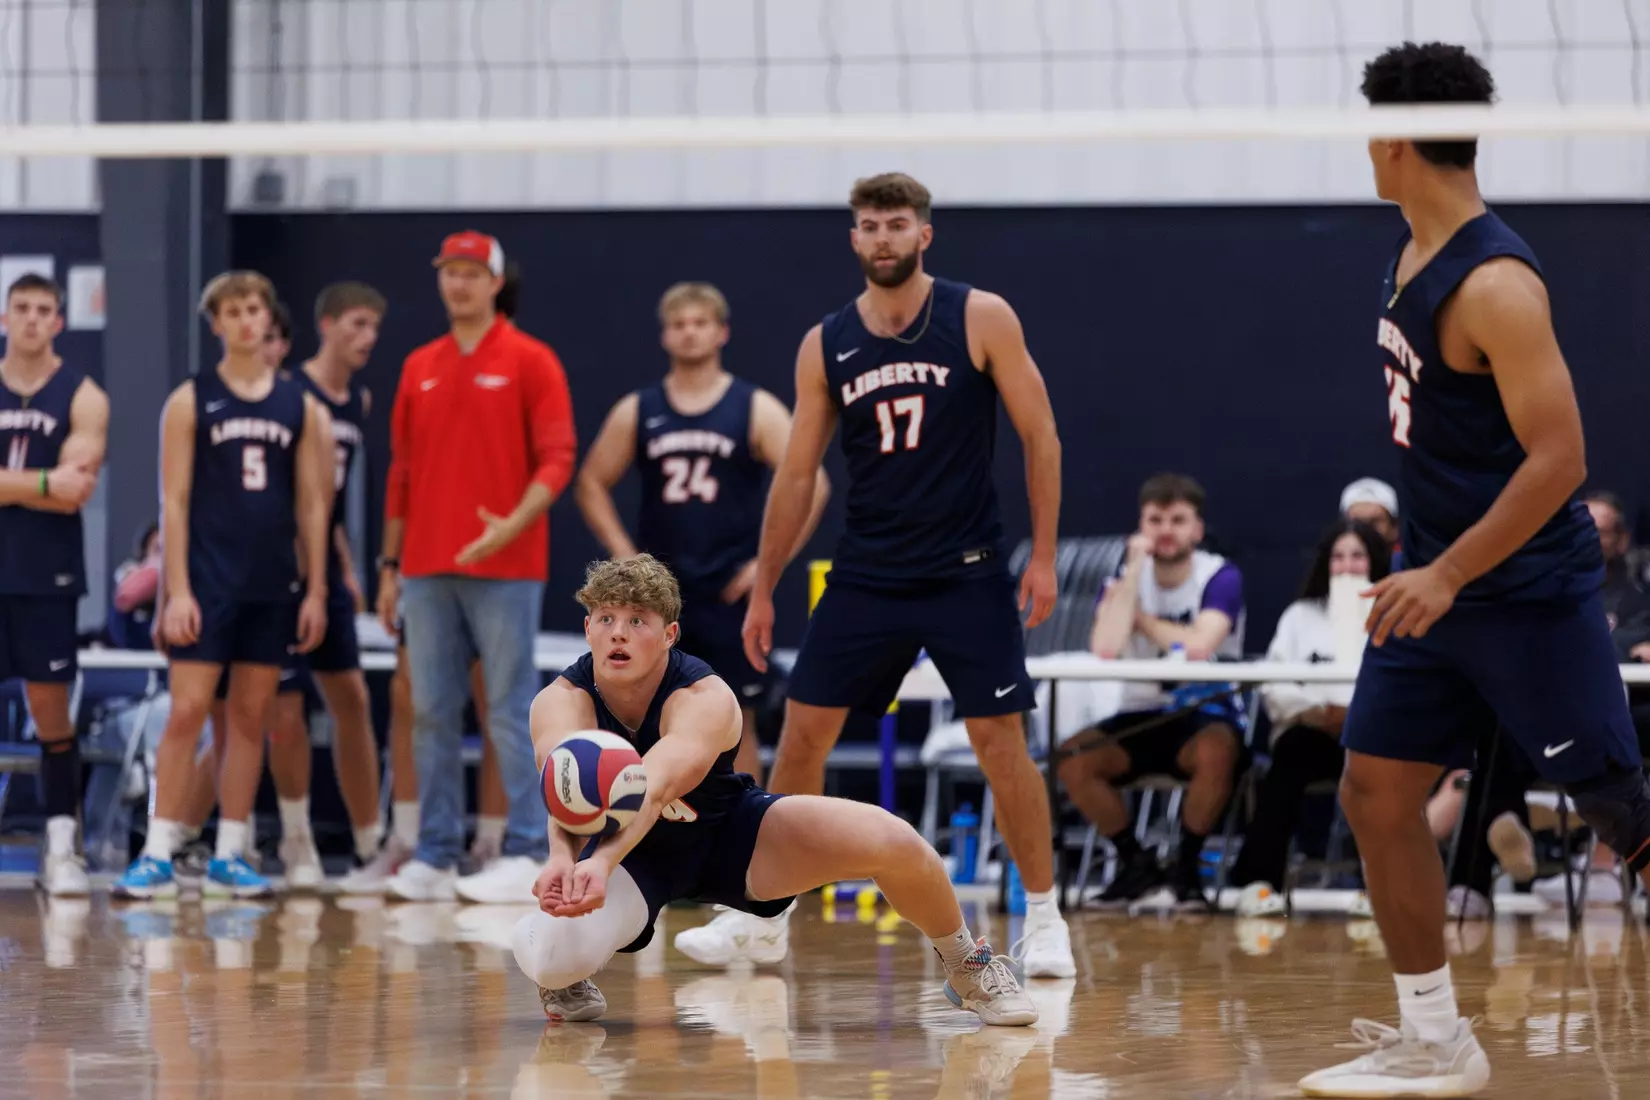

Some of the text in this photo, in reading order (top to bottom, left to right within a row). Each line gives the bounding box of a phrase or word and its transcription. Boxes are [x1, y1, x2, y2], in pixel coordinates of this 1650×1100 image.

[841, 362, 950, 407] LIBERTY
[210, 417, 293, 449] LIBERTY
[646, 429, 736, 459] LIBERTY
[874, 394, 926, 455] 17
[242, 445, 267, 492] 5
[662, 456, 719, 504] 24
[561, 756, 573, 805] molten
